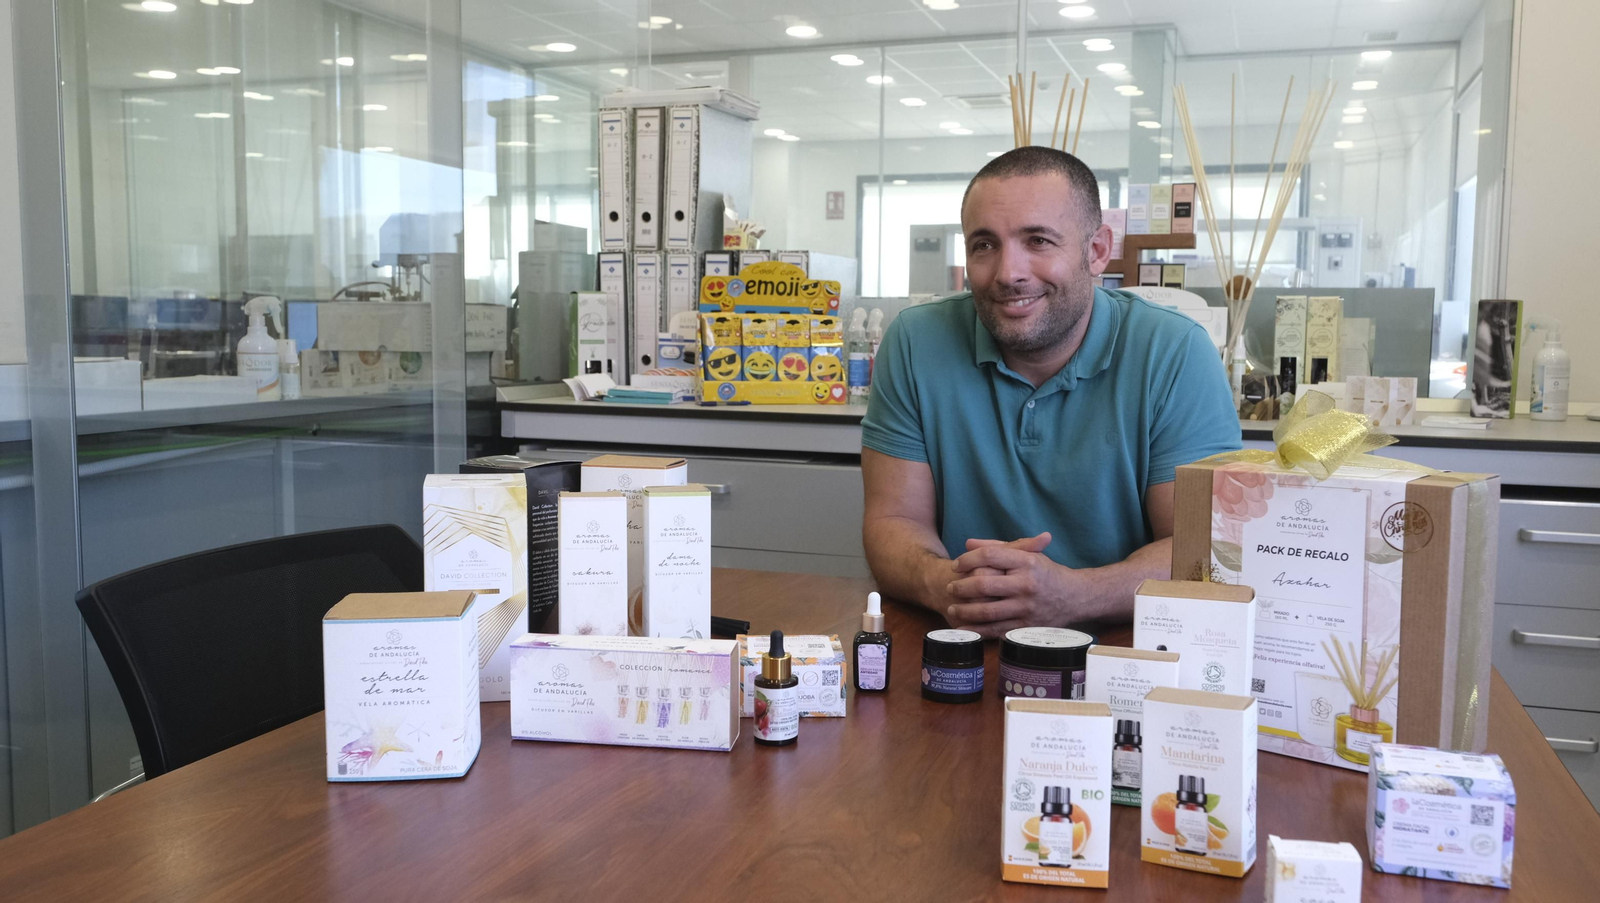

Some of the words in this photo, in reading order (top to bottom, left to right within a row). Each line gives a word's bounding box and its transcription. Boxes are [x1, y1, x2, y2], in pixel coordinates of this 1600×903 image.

[751, 265, 776, 276] Cool
[780, 268, 797, 276] car
[745, 277, 800, 297] emoji
[1280, 515, 1327, 524] aromas
[1288, 523, 1330, 531] ANDALUCÍA
[666, 552, 693, 560] dama
[1256, 544, 1286, 556] PACK
[1287, 547, 1302, 557] DE
[1304, 549, 1350, 562] REGALO
[673, 559, 701, 567] noche
[572, 567, 614, 576] sakura
[1205, 628, 1226, 637] Rosa
[1194, 634, 1237, 646] Mosqueta
[620, 664, 663, 672] COLECCIÓN
[1268, 657, 1301, 667] experiencia
[1302, 661, 1326, 669] olfativa!
[360, 669, 430, 683] estrella
[930, 669, 973, 679] laCosmética
[1111, 676, 1151, 684] aromas
[364, 683, 384, 695] de
[390, 687, 427, 695] mar
[546, 688, 588, 696] ANDALUCÍA
[1170, 726, 1216, 736] aromas
[1178, 733, 1220, 743] ANDALUCÍA
[1043, 743, 1086, 751] ANDALUCÍA
[1161, 745, 1225, 764] Mandarina
[1020, 758, 1063, 772] Naranja
[1066, 761, 1098, 772] Dulce
[1081, 789, 1104, 800] BIO
[1411, 797, 1463, 810] laCosmética
[1392, 826, 1429, 834] HIDRATANTE
[1176, 860, 1196, 868] ORIGEN
[1197, 863, 1220, 872] NATURAL
[1195, 857, 1211, 865] TOTAL
